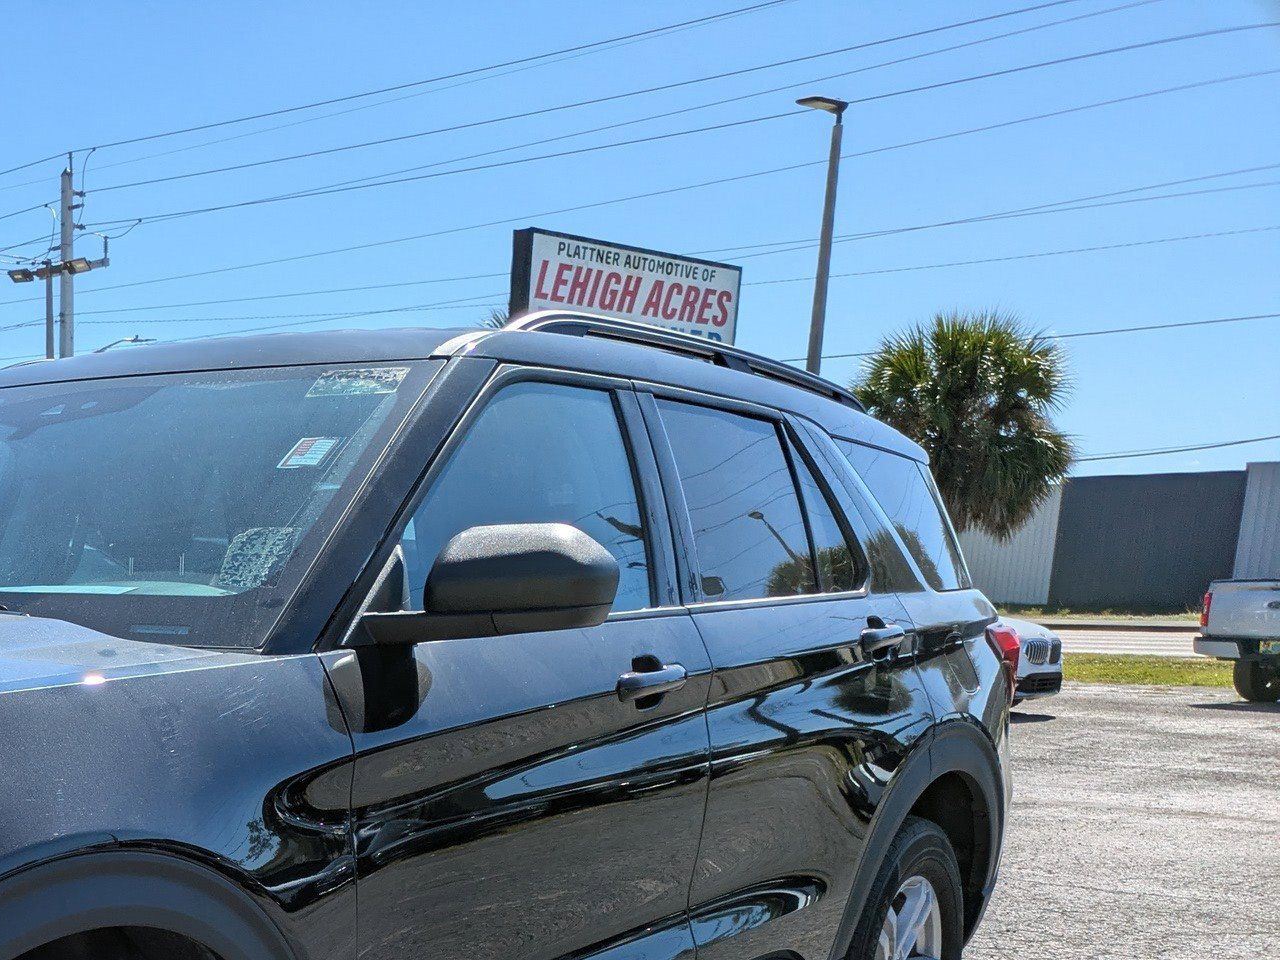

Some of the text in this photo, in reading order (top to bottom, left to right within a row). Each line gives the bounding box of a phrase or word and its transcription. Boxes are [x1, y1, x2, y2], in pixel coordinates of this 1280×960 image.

[557, 241, 717, 283] PLATTNER AUTOMOTIVE OF
[534, 259, 732, 327] LEHIGH ACRES
